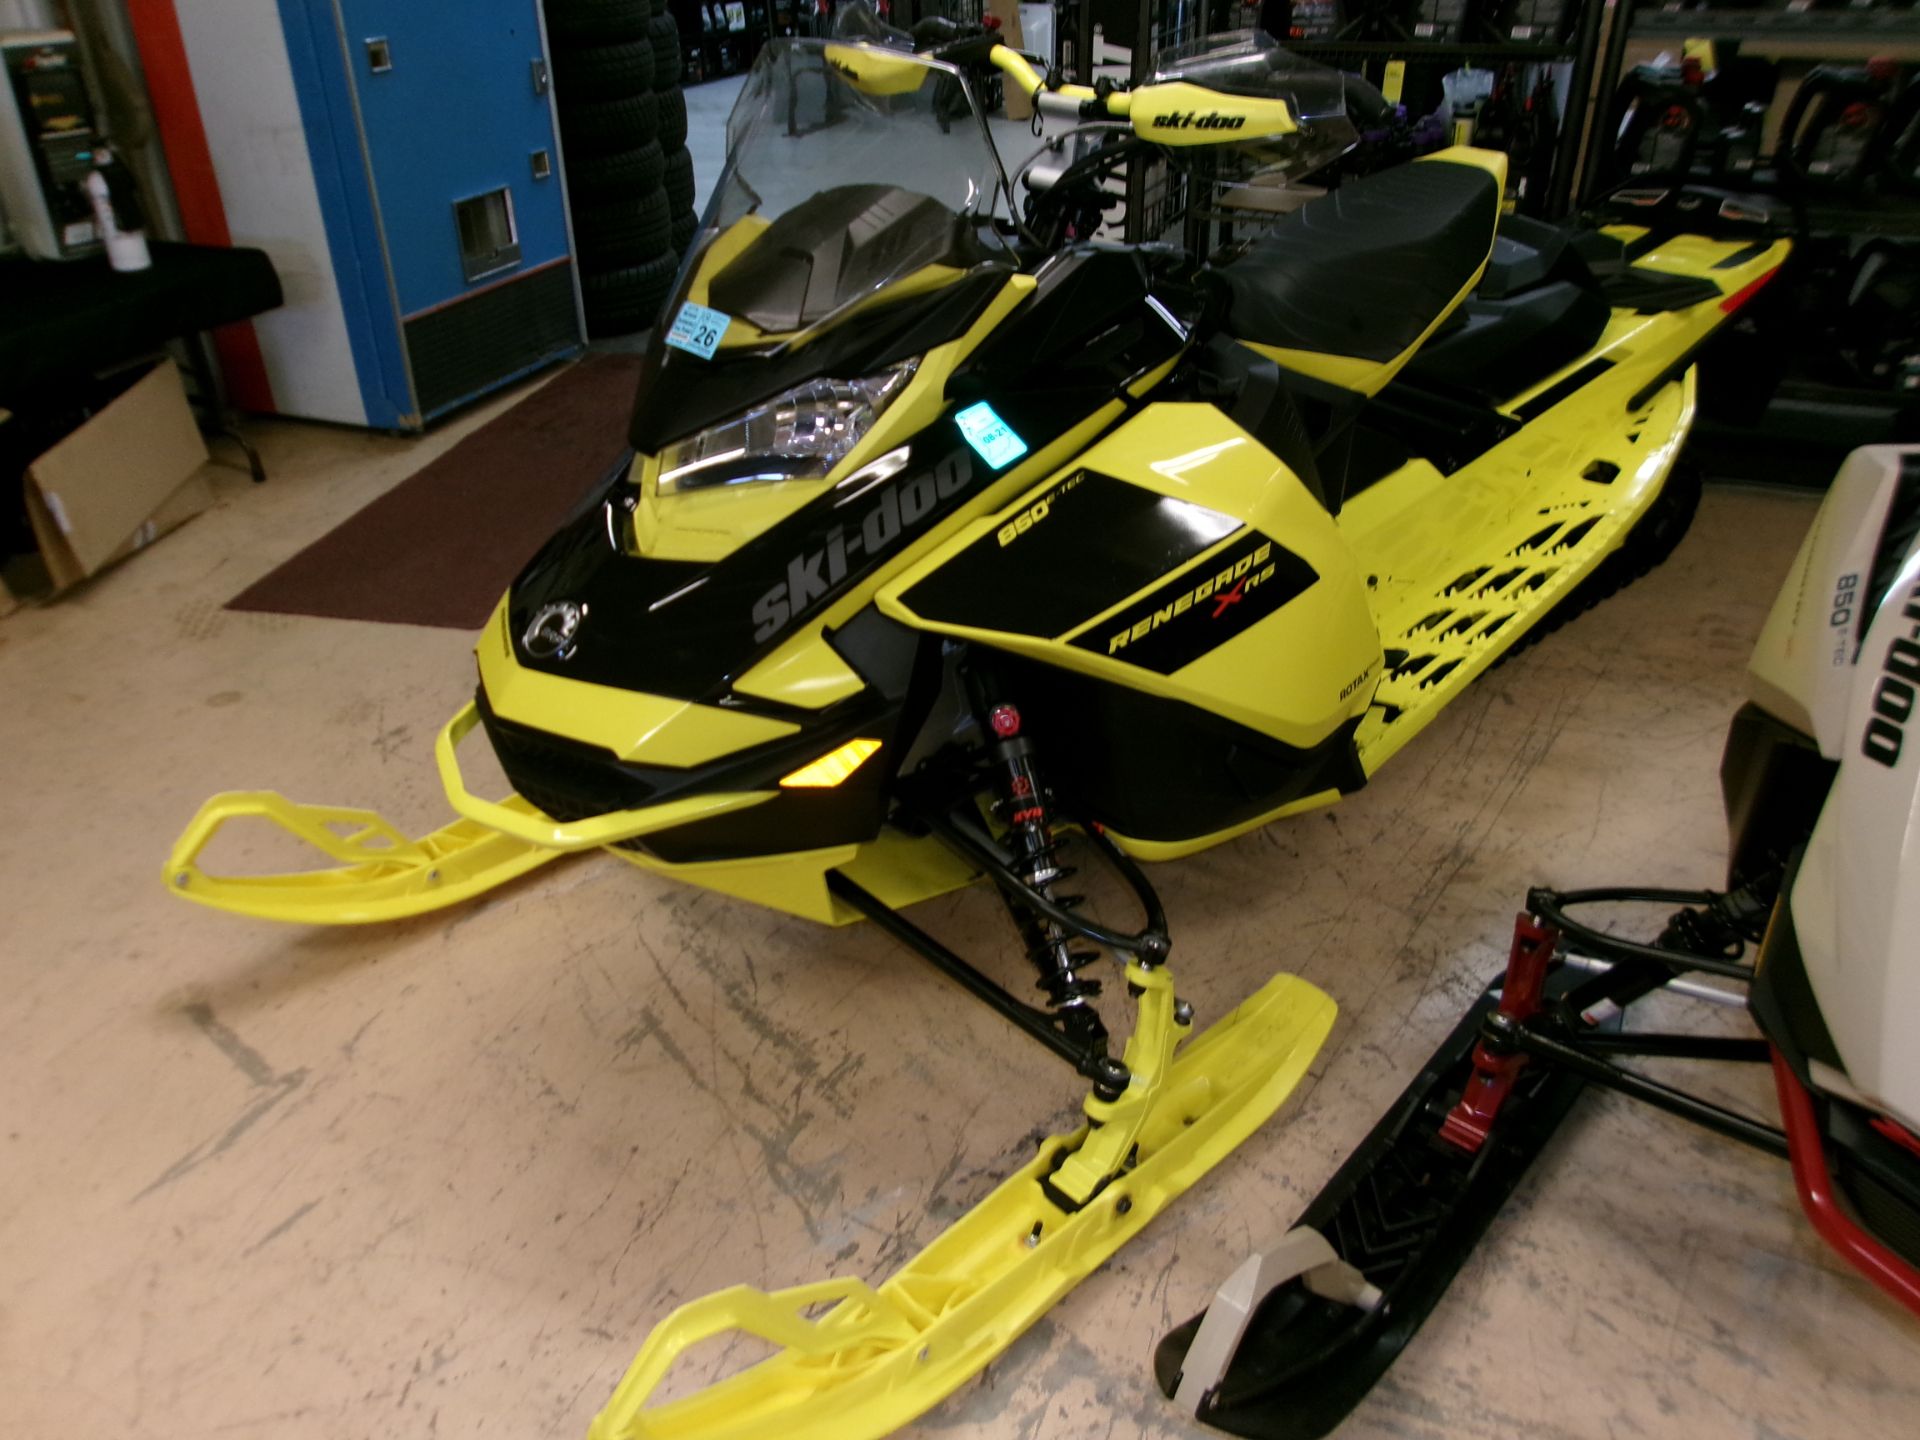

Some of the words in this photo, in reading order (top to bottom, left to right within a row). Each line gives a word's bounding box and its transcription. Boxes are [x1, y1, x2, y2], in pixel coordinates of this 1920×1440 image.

[1152, 110, 1247, 131] ski-doo
[693, 325, 717, 347] 26
[982, 426, 1008, 444] 08-21
[997, 499, 1049, 548] 850
[752, 446, 973, 644] ski-doo
[1109, 540, 1271, 655] RENEGADE
[1830, 573, 1859, 628] 850
[1339, 667, 1369, 702] ROTAX
